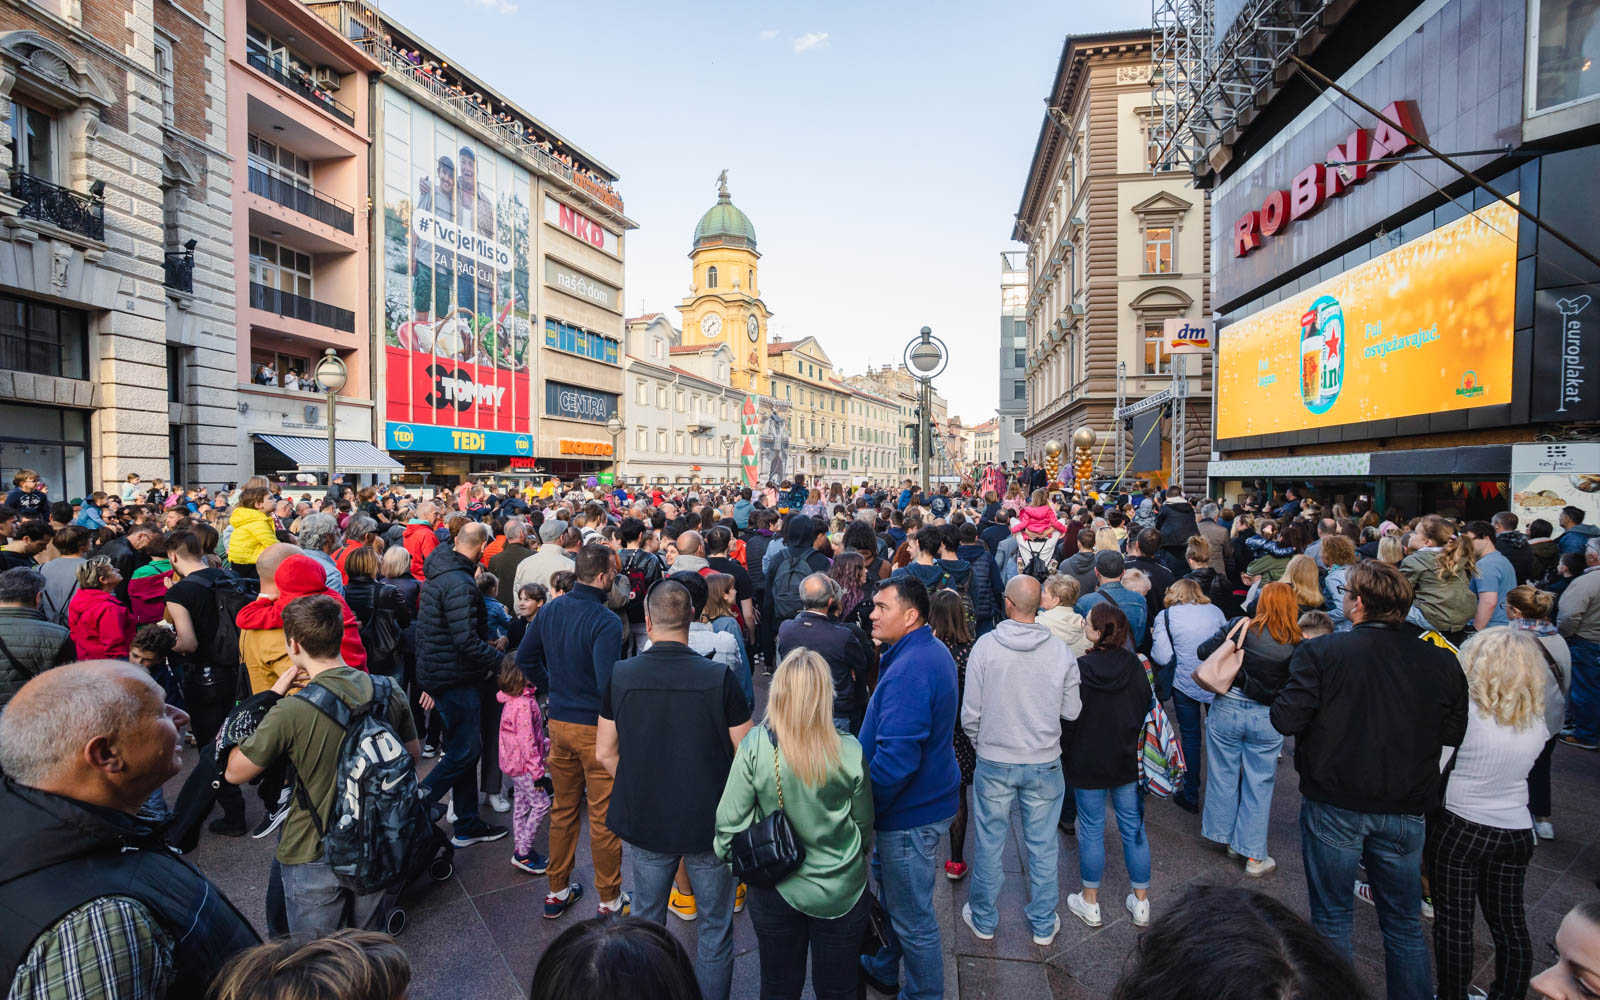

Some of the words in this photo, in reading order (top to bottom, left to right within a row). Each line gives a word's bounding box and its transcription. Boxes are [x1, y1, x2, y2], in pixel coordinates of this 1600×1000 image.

[1234, 100, 1420, 258] ROBNA
[560, 203, 604, 248] NKD
[434, 251, 448, 267] ZA
[558, 272, 577, 291] naš
[588, 284, 608, 304] dom
[1177, 323, 1206, 339] dm
[1563, 320, 1585, 403] europlakat
[441, 376, 506, 407] TOMMY
[560, 391, 606, 417] CENTRA
[394, 431, 414, 442] TEDi
[451, 431, 485, 451] TEDi
[515, 440, 529, 449] TEDi
